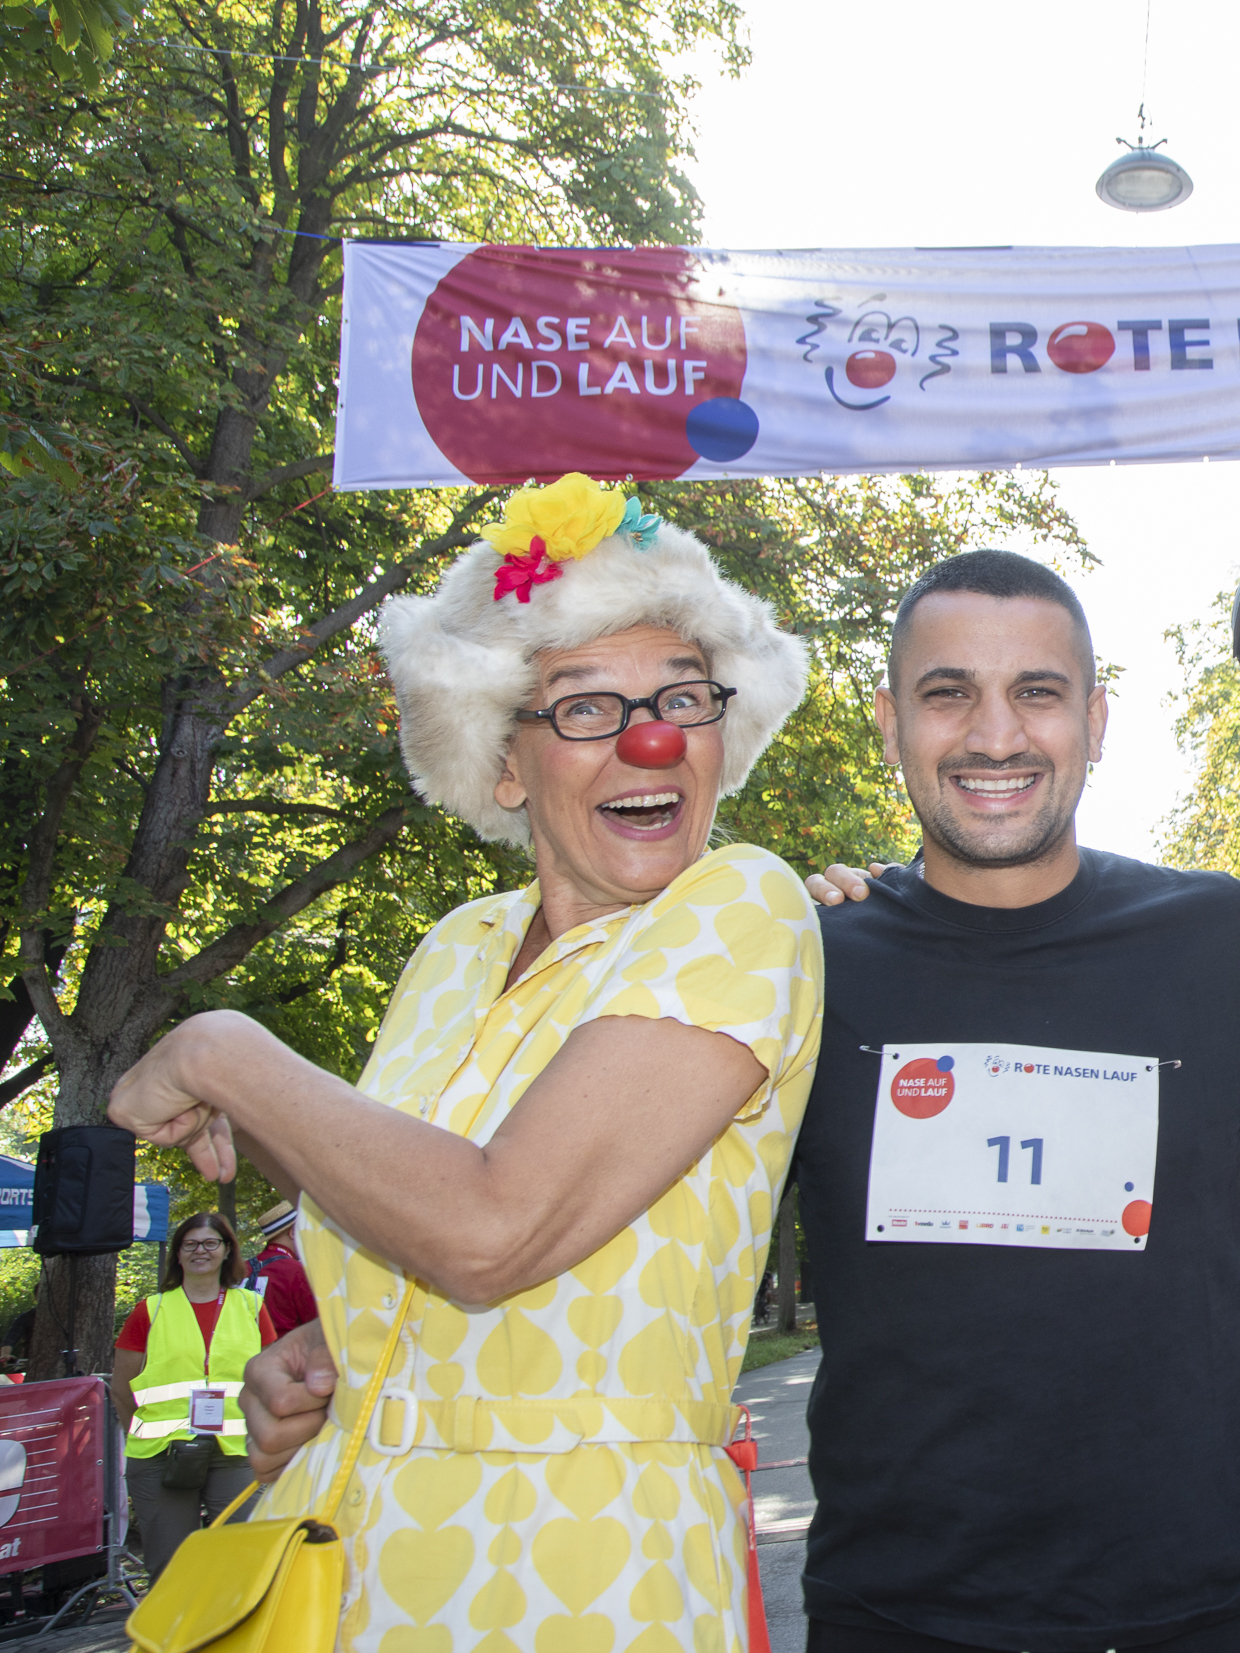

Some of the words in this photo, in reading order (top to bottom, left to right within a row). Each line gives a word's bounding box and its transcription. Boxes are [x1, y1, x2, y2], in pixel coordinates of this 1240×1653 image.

[460, 315, 591, 351] NASE
[603, 315, 702, 350] AUF
[989, 319, 1214, 374] ROTE
[452, 360, 562, 401] UND
[578, 358, 707, 396] LAUF
[899, 1078, 926, 1087] NASE
[927, 1078, 947, 1086] AUF
[1014, 1062, 1050, 1075] ROTE
[1054, 1066, 1100, 1079] NASEN
[1103, 1070, 1138, 1082] LAUF
[897, 1088, 920, 1097] UND
[921, 1088, 948, 1097] LAUF
[986, 1135, 1044, 1185] 11
[0, 1188, 34, 1205] ORTS
